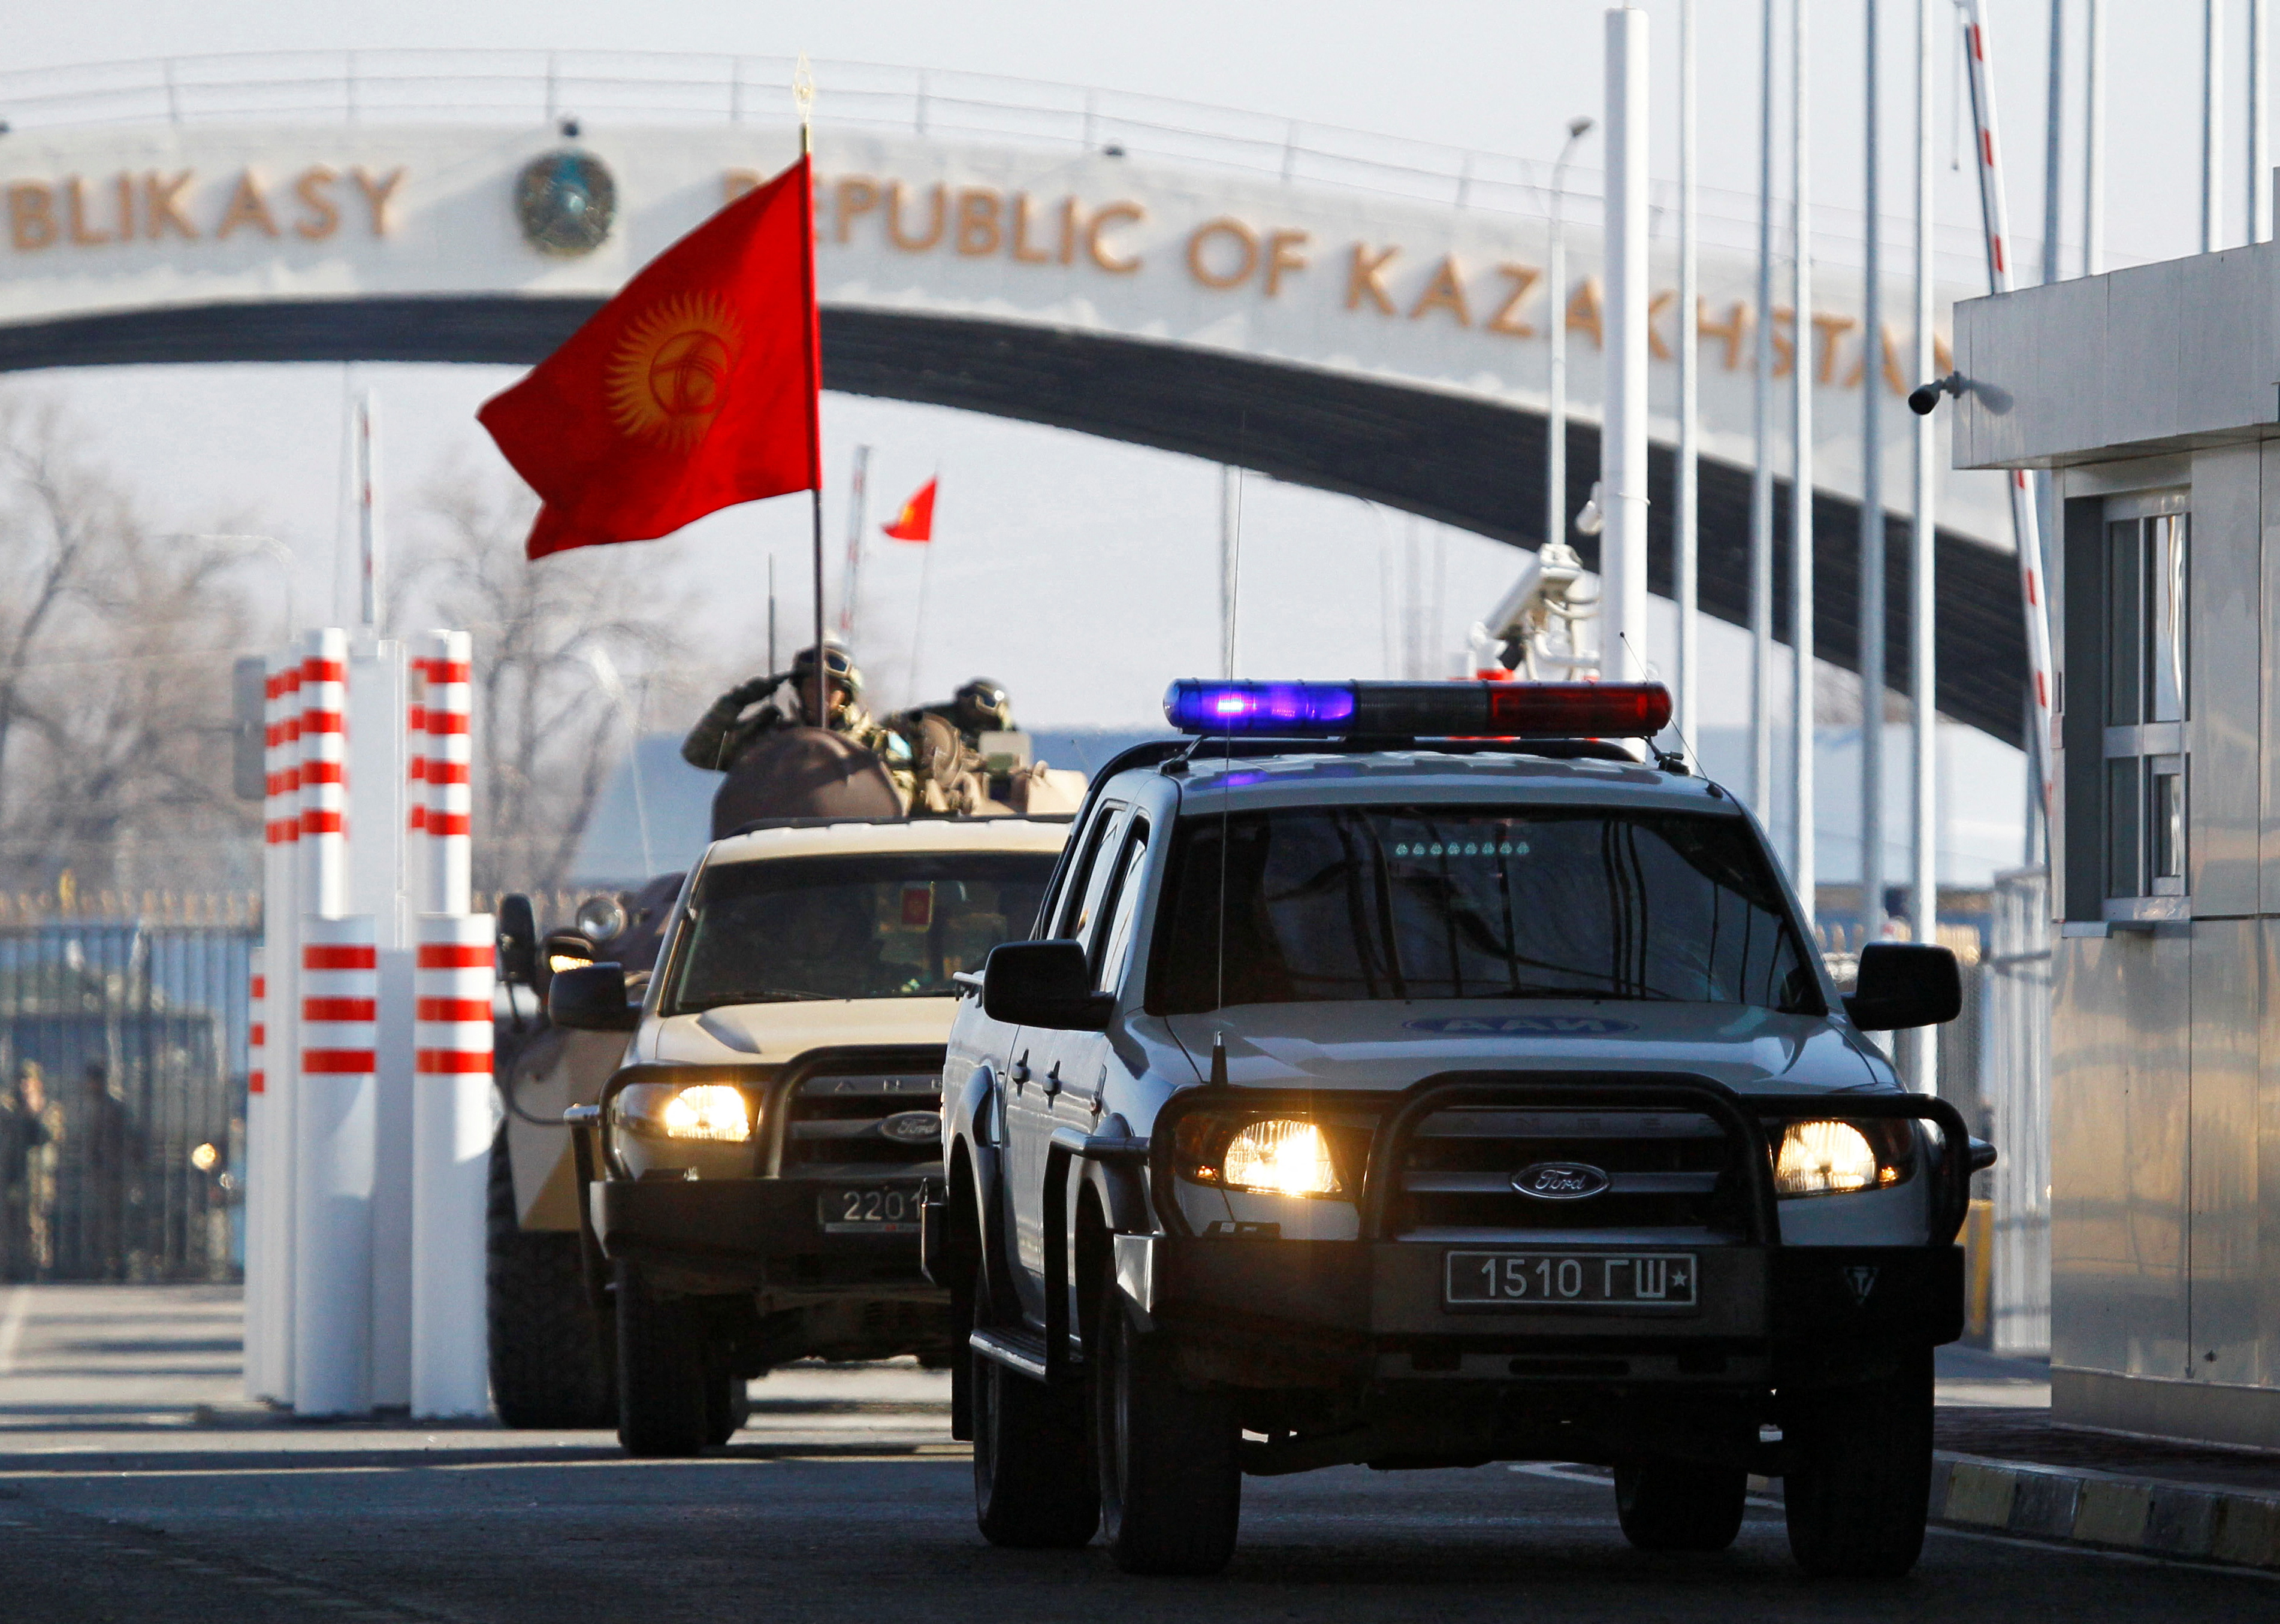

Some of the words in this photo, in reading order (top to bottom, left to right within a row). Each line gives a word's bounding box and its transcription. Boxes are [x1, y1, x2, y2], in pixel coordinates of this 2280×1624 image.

[7, 164, 407, 252] BLIKASY
[723, 168, 1144, 274] PUBLIC
[1185, 216, 1311, 298] OF
[897, 1118, 938, 1135] Ford
[1535, 1169, 1586, 1190] Ford
[844, 1190, 921, 1220] 2201
[1481, 1259, 1582, 1298] 1510
[1604, 1259, 1667, 1299] ГШ
